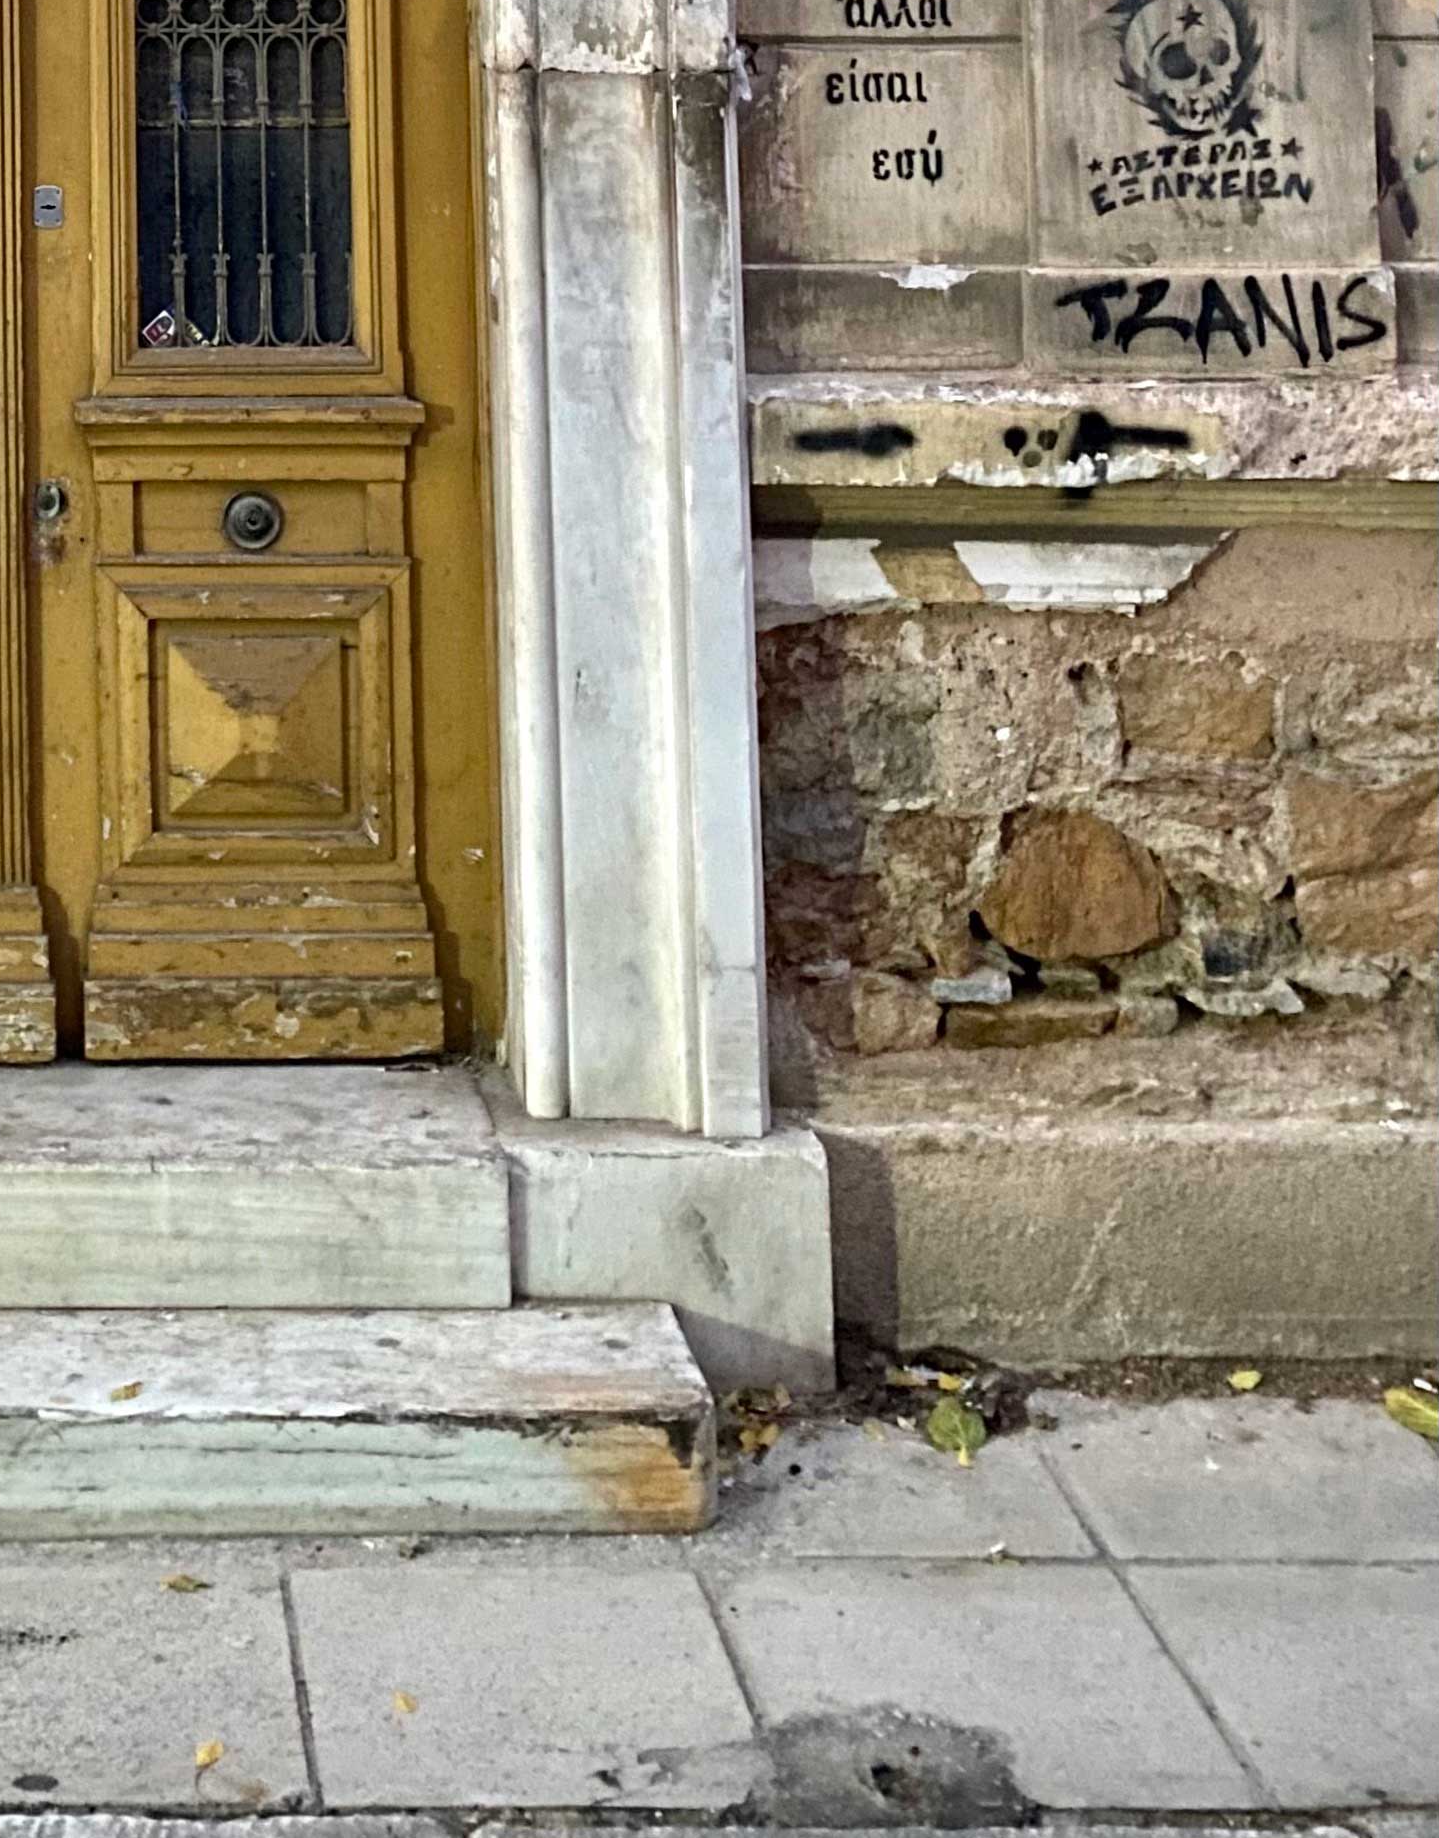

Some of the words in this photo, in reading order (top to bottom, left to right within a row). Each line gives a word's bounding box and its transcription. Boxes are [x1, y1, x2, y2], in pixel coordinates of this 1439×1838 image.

[825, 58, 928, 104] είσαι
[872, 129, 944, 184] εσύ
[1111, 139, 1272, 176] ΑΣΤΕΡΑΣ
[1089, 168, 1314, 217] ΕΞΑΡΧΕΙΩΝ
[1055, 273, 1387, 368] TZANIS
